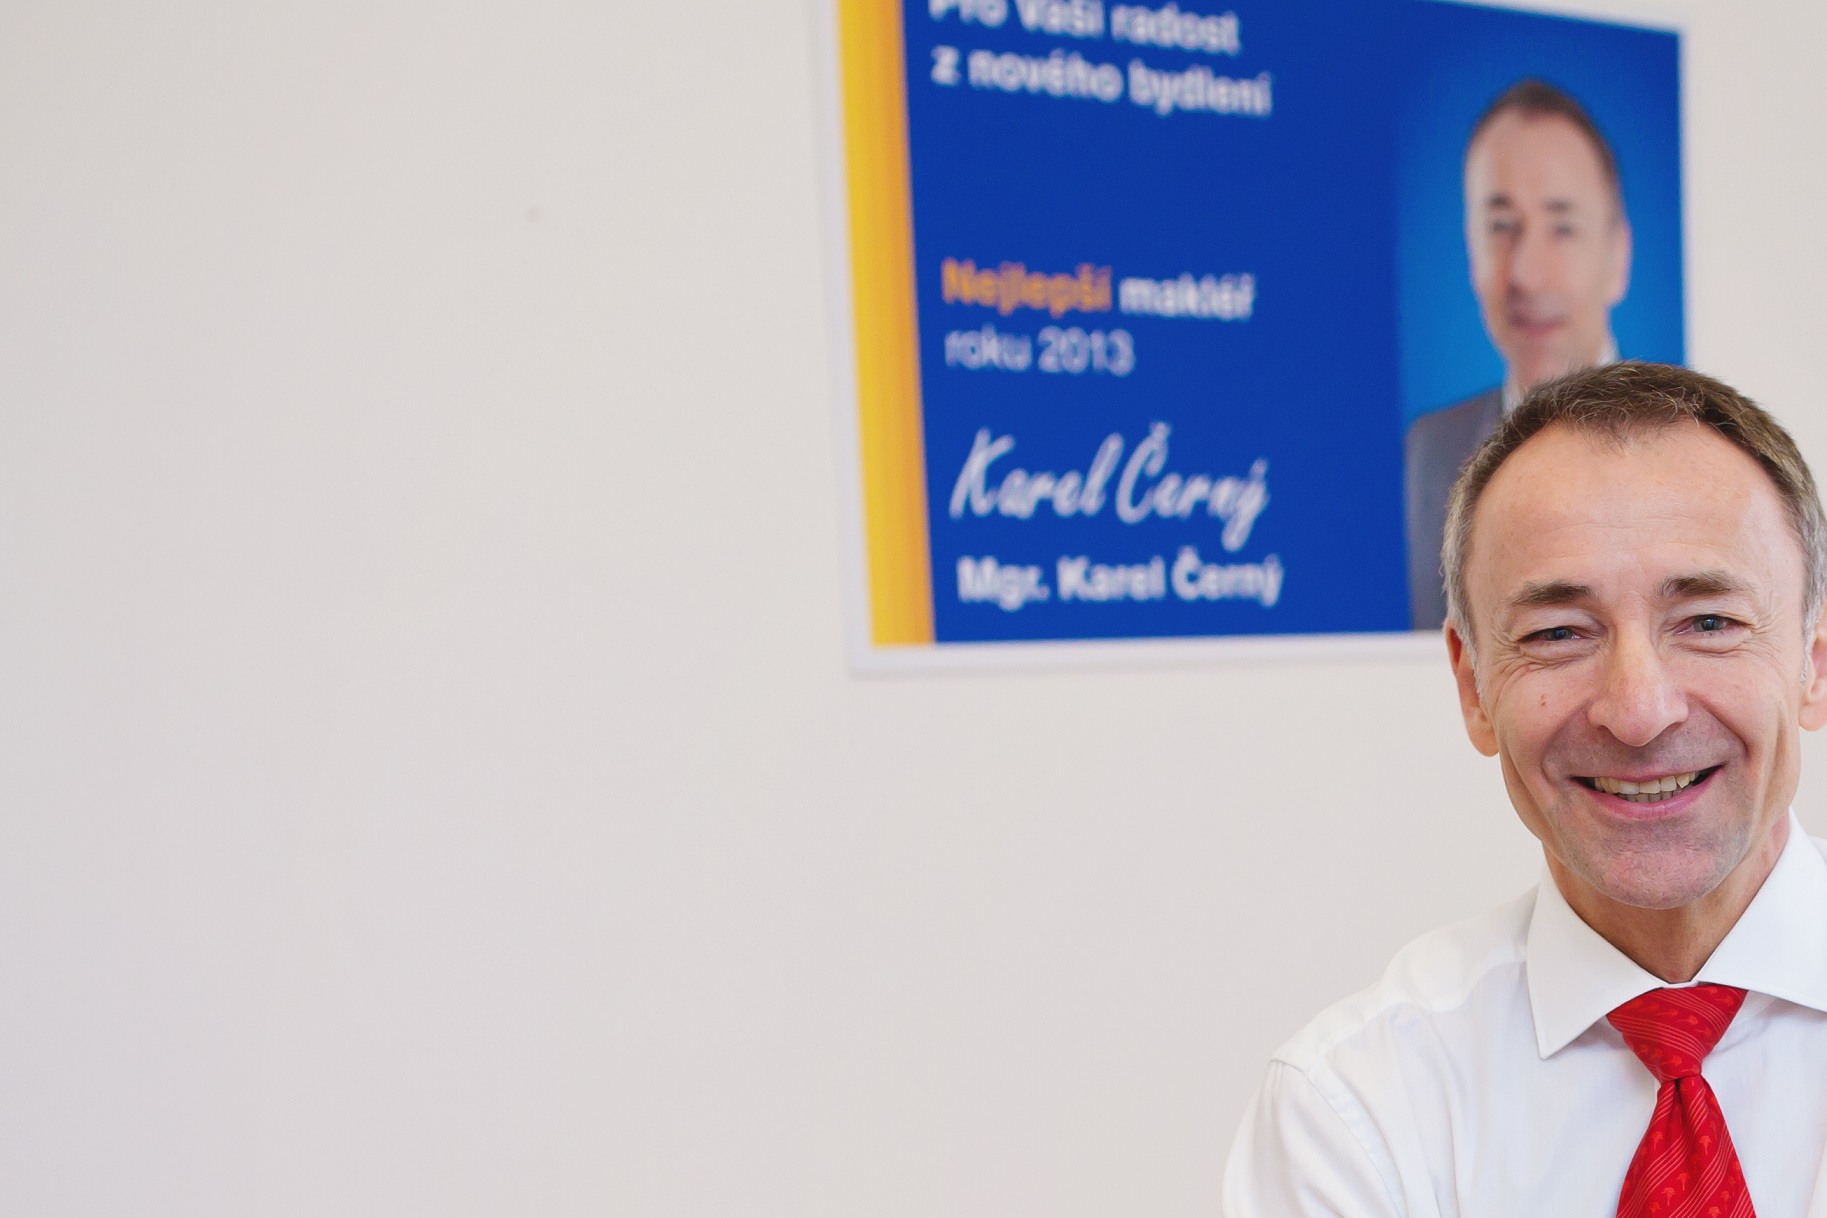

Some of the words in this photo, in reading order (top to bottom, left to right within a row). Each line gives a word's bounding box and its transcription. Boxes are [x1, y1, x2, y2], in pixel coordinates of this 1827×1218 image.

[1110, 3, 1240, 55] radost
[930, 45, 960, 85] z
[967, 49, 1124, 102] nového
[1127, 58, 1272, 116] bydlení
[941, 257, 1112, 317] Nejlepší
[944, 324, 1032, 371] roku
[1037, 325, 1135, 376] 2013
[949, 427, 1124, 519] Karel
[1116, 421, 1269, 551] Černý
[956, 555, 1050, 611] Mgr.
[1056, 554, 1166, 601] Karel
[1171, 546, 1283, 607] Černý
